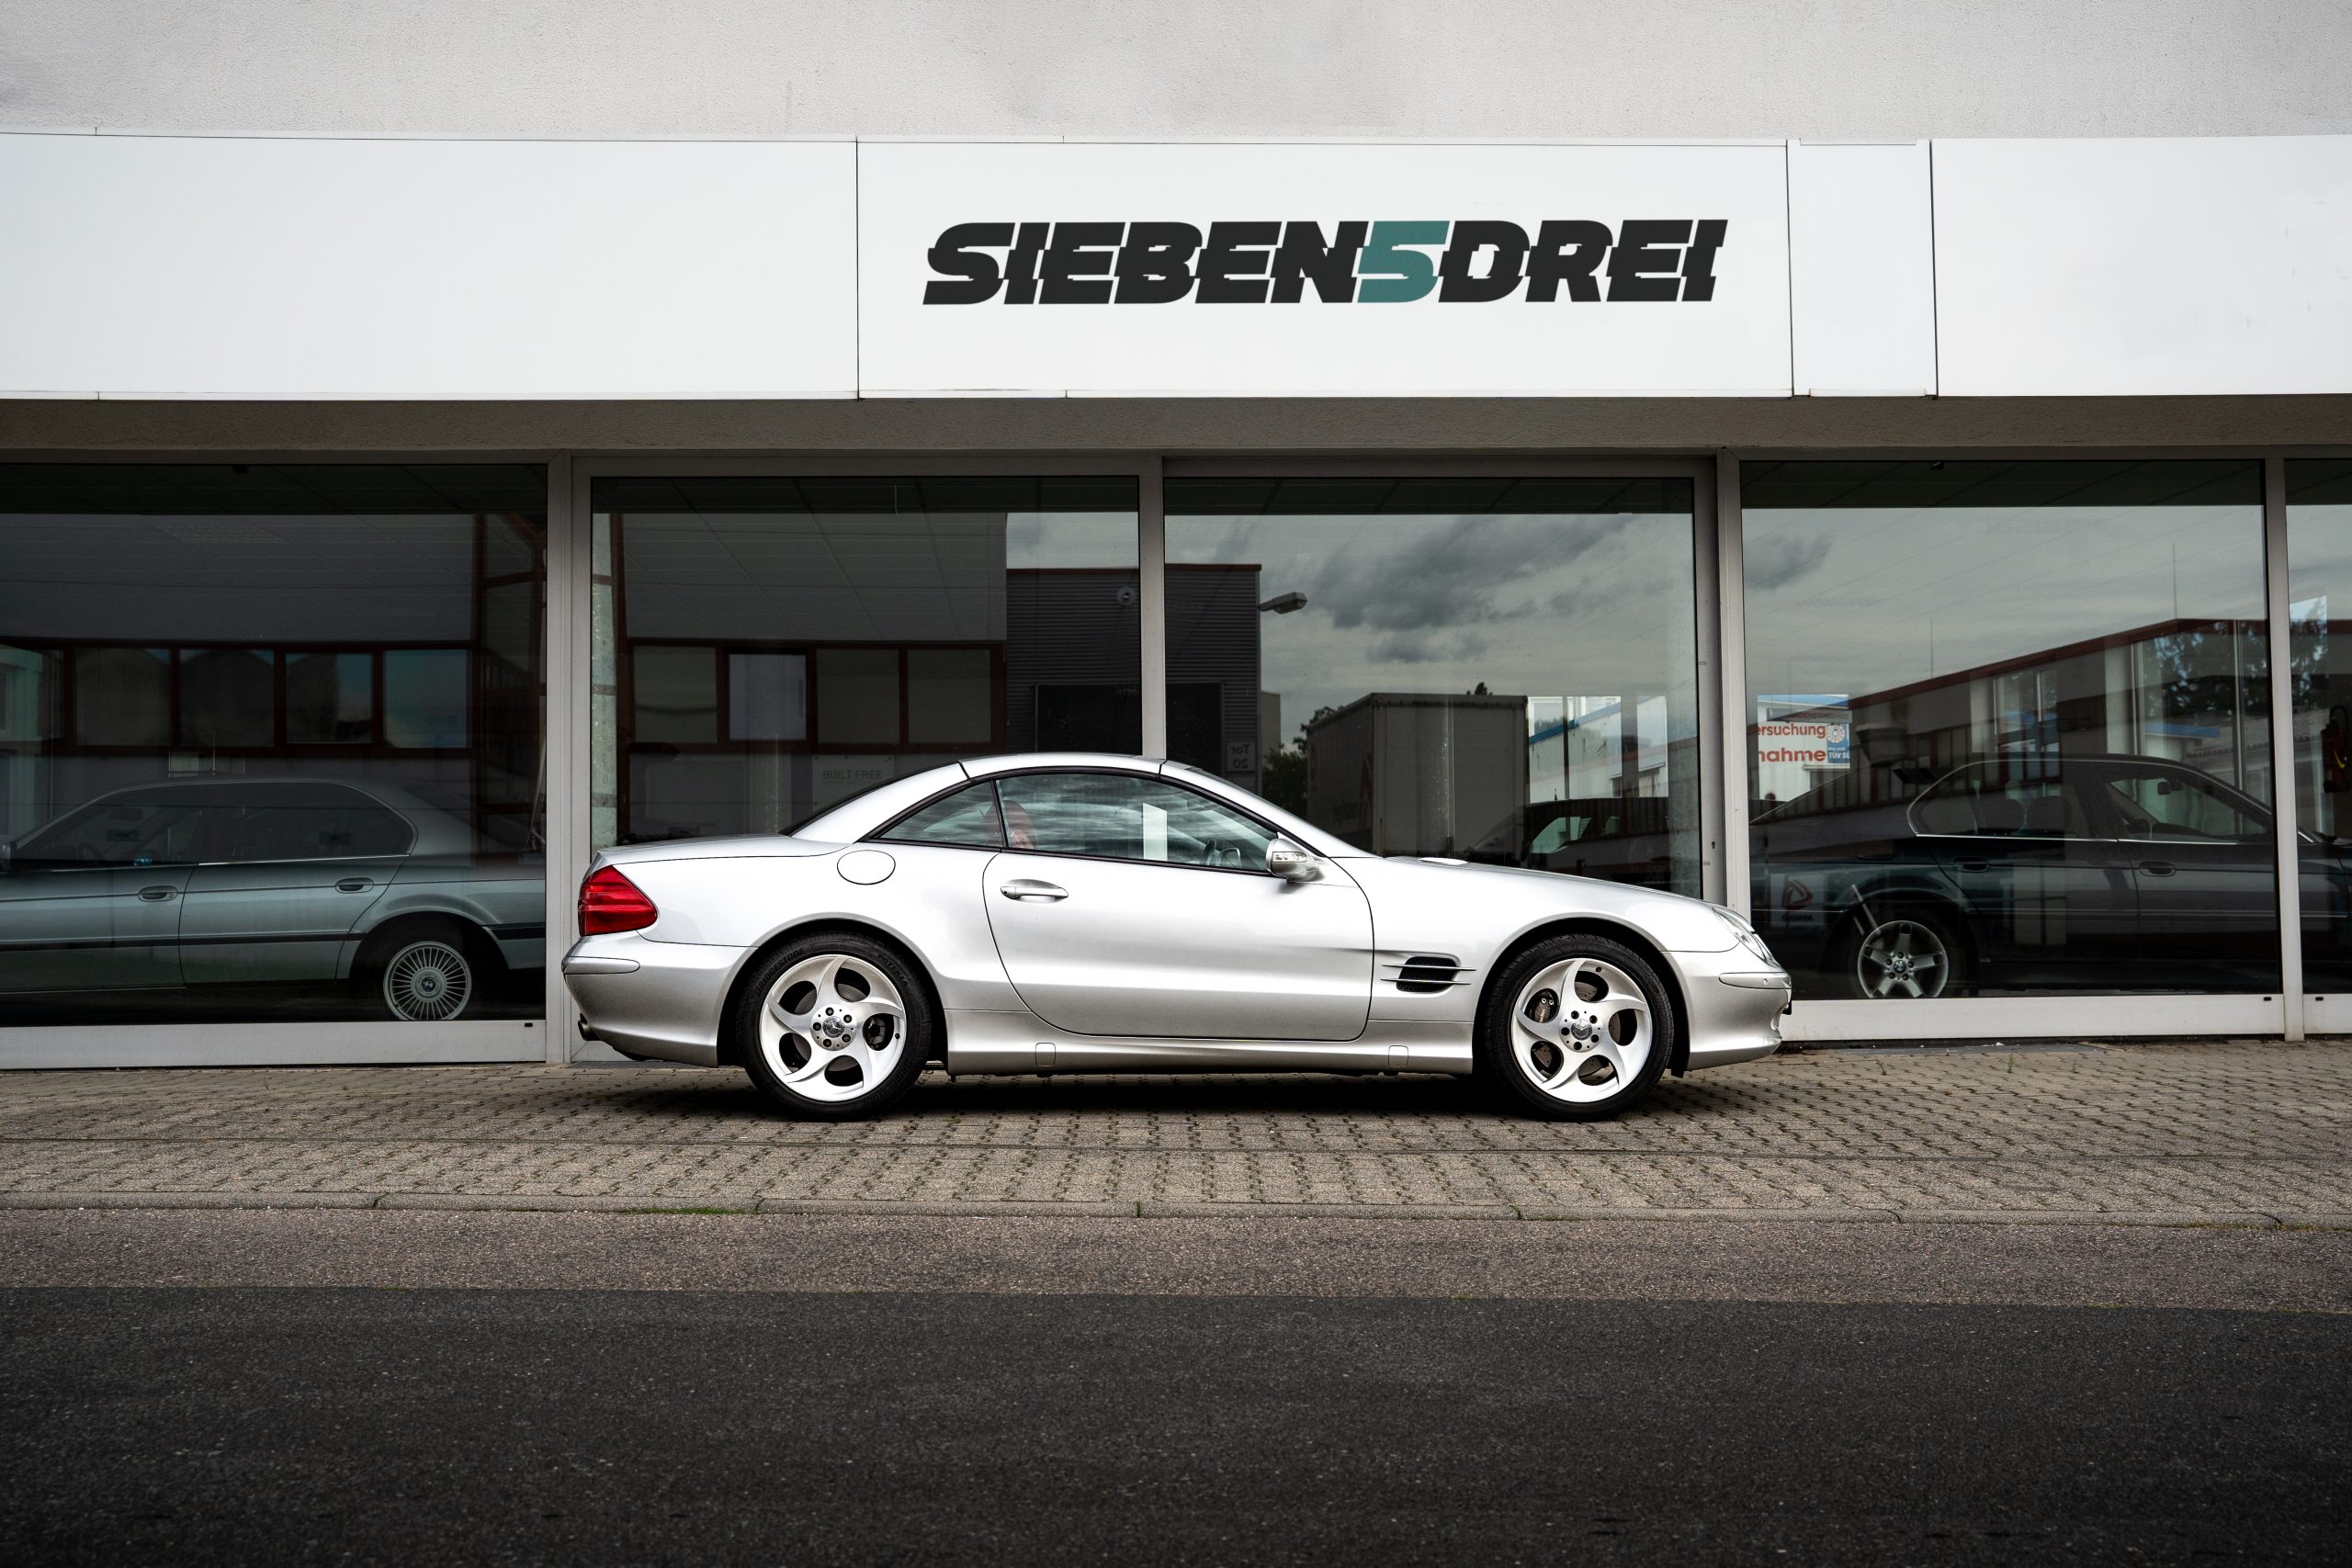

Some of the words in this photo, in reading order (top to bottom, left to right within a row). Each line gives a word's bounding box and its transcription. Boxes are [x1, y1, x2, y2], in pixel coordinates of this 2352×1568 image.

[923, 220, 1728, 305] SIEBEN5DREI
[823, 770, 853, 780] BUILT
[854, 770, 883, 780] FREE
[754, 947, 804, 997] BRIDGESTONE
